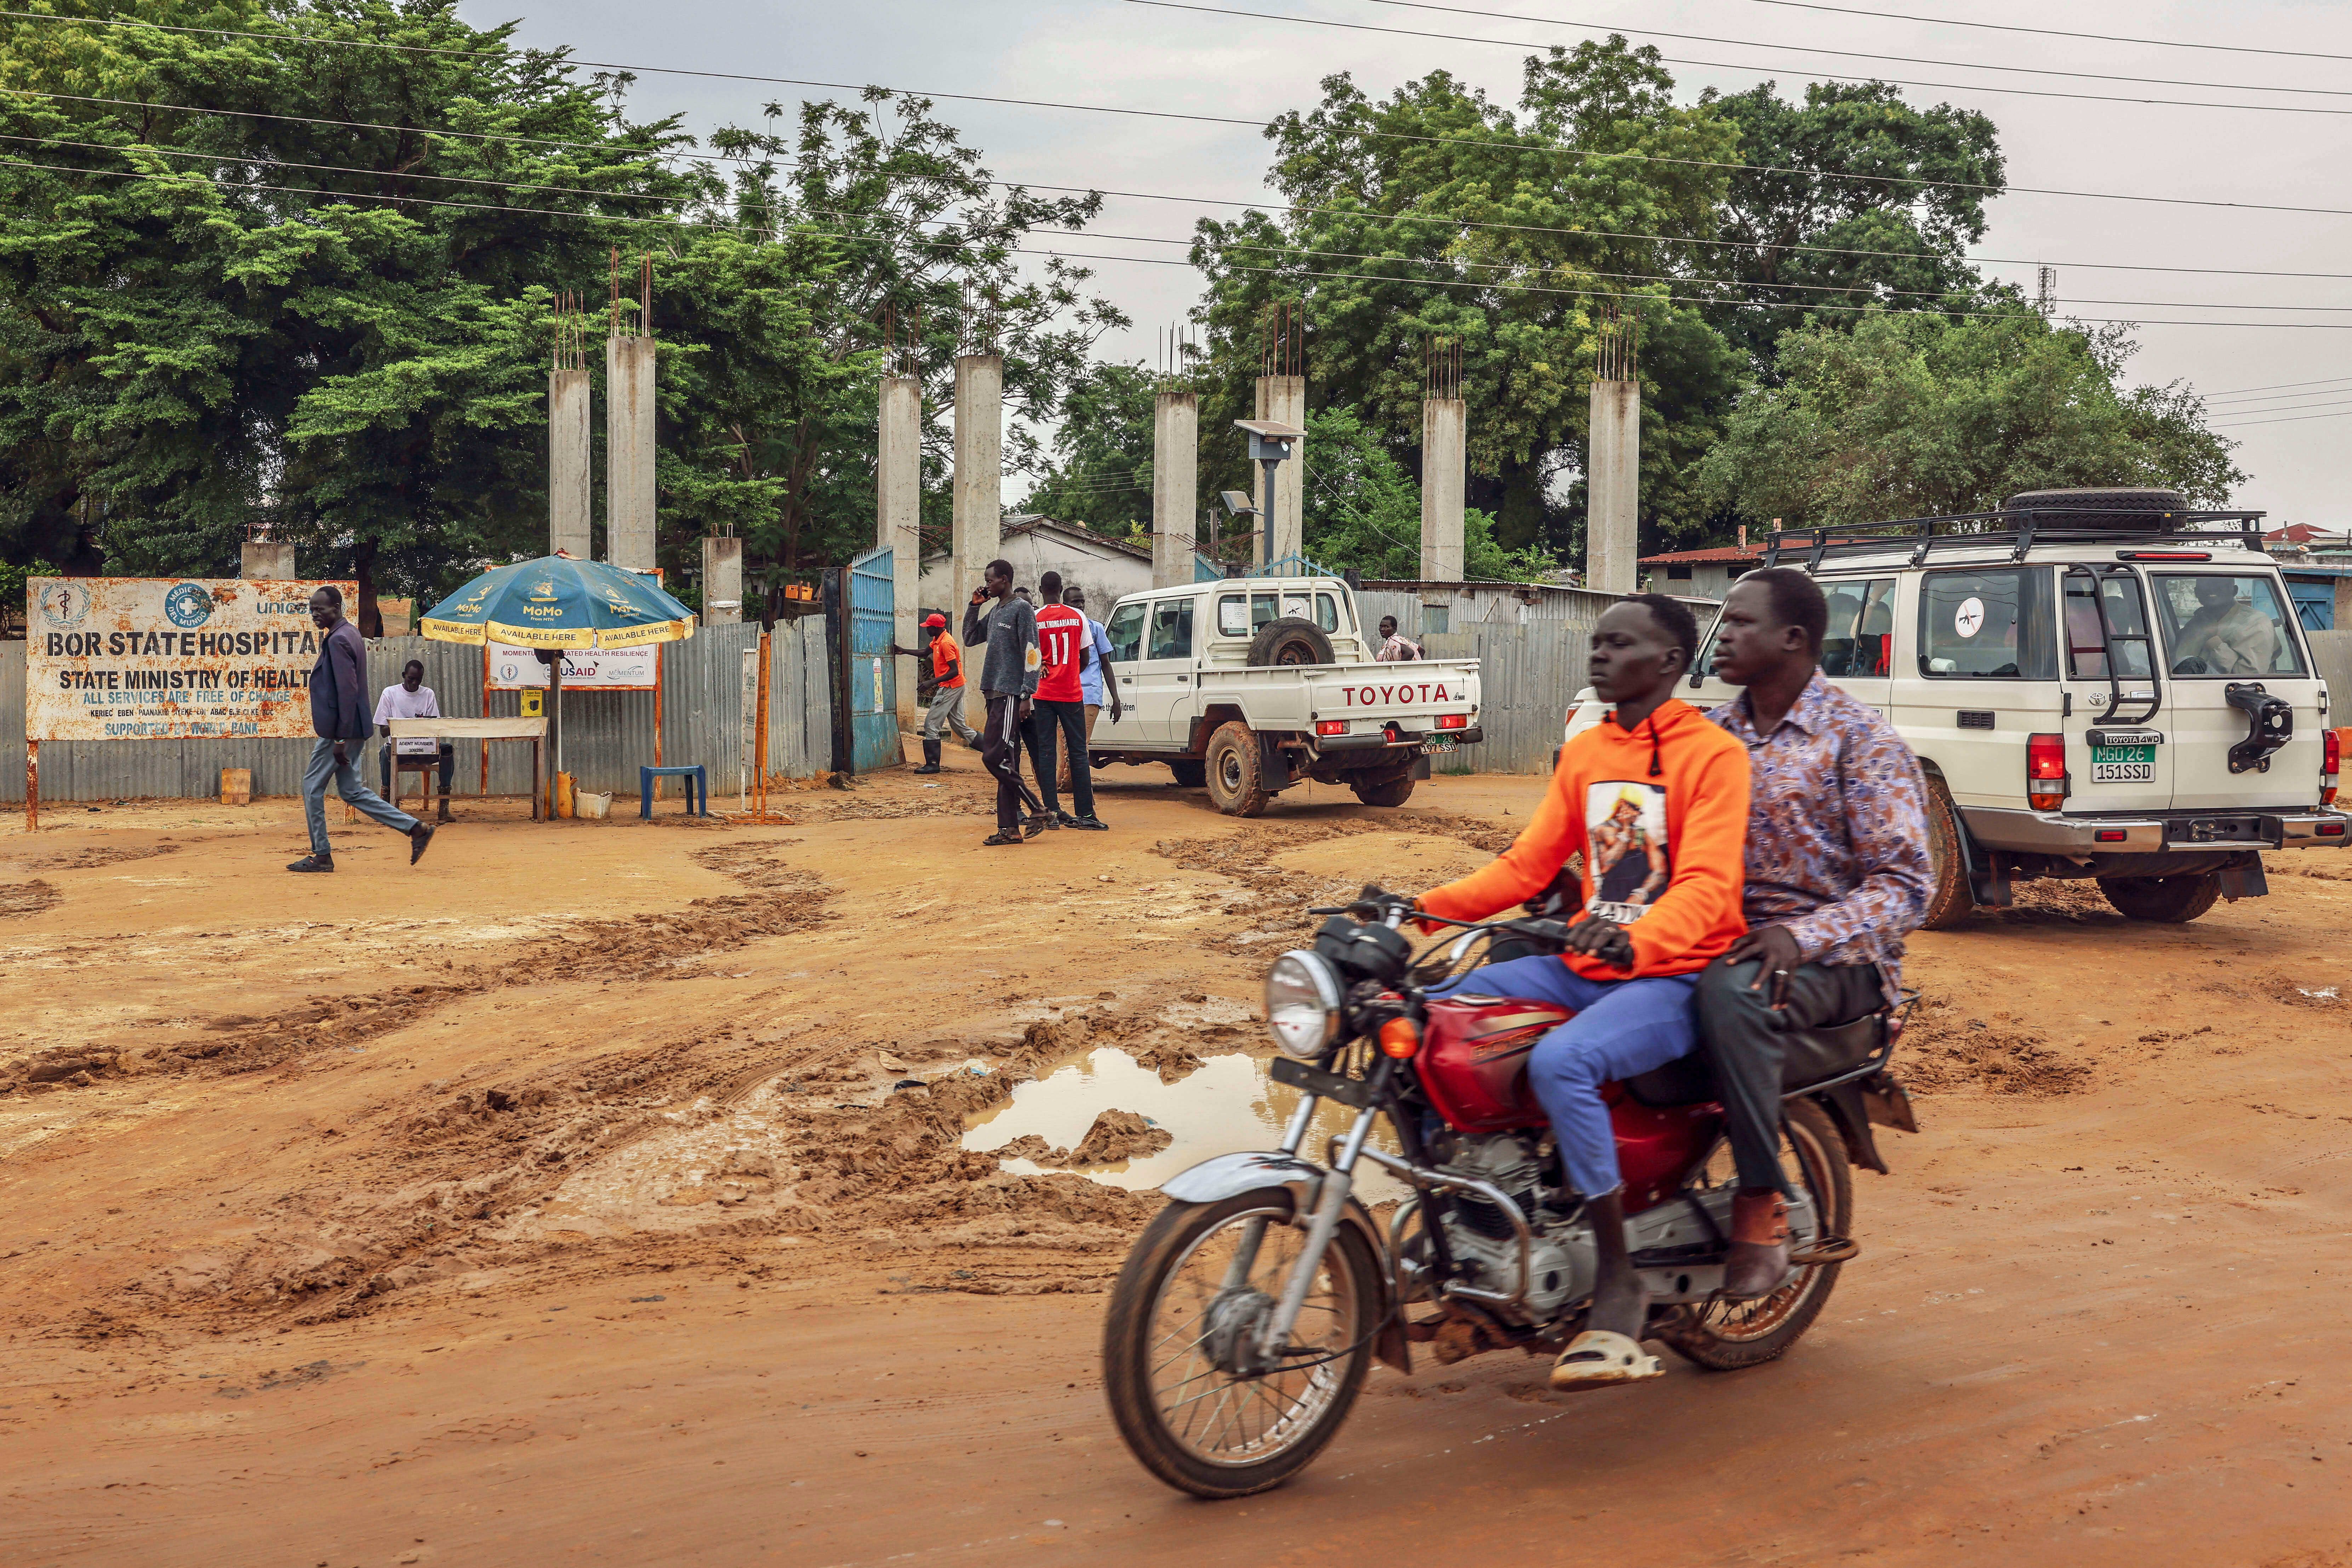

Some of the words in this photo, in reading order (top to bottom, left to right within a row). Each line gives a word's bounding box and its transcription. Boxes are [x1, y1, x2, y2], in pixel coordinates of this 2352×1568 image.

[257, 598, 312, 614] unice
[454, 603, 482, 613] MoMo
[523, 606, 563, 616] MoMo
[609, 604, 641, 614] MoMo
[168, 606, 178, 621] DEL
[179, 612, 206, 626] MUNDO
[433, 624, 464, 634] AVAILABLE
[501, 629, 549, 640] AVAILABLE
[605, 630, 646, 642] AVAILABLE
[648, 626, 670, 635] HERE
[47, 632, 102, 656] BOR
[109, 632, 195, 656] STATE
[1049, 632, 1069, 665] 11
[60, 670, 118, 689] STATE
[125, 670, 222, 689] MINISTRY
[228, 670, 249, 689] OF
[255, 669, 311, 688] HEALT
[560, 668, 596, 676] USAID
[746, 672, 755, 690] Digite
[83, 692, 104, 704] ALL
[108, 690, 165, 704] SERVICES
[168, 690, 189, 703] ARE
[196, 690, 224, 702] FREE
[230, 690, 245, 702] OF
[249, 690, 290, 702] CHARGE
[1342, 684, 1449, 706] TOYOTA
[1121, 703, 1135, 711] ildren
[105, 723, 169, 736] SUPPORTED
[175, 723, 188, 735] BY
[232, 722, 259, 735] BANK
[1426, 735, 1436, 744] GO
[1443, 735, 1453, 743] 26
[1421, 744, 1437, 753] 197
[1440, 743, 1457, 752] SSD
[2096, 746, 2123, 762] NGO
[2126, 746, 2144, 761] 26
[2097, 764, 2150, 780] 151SSD
